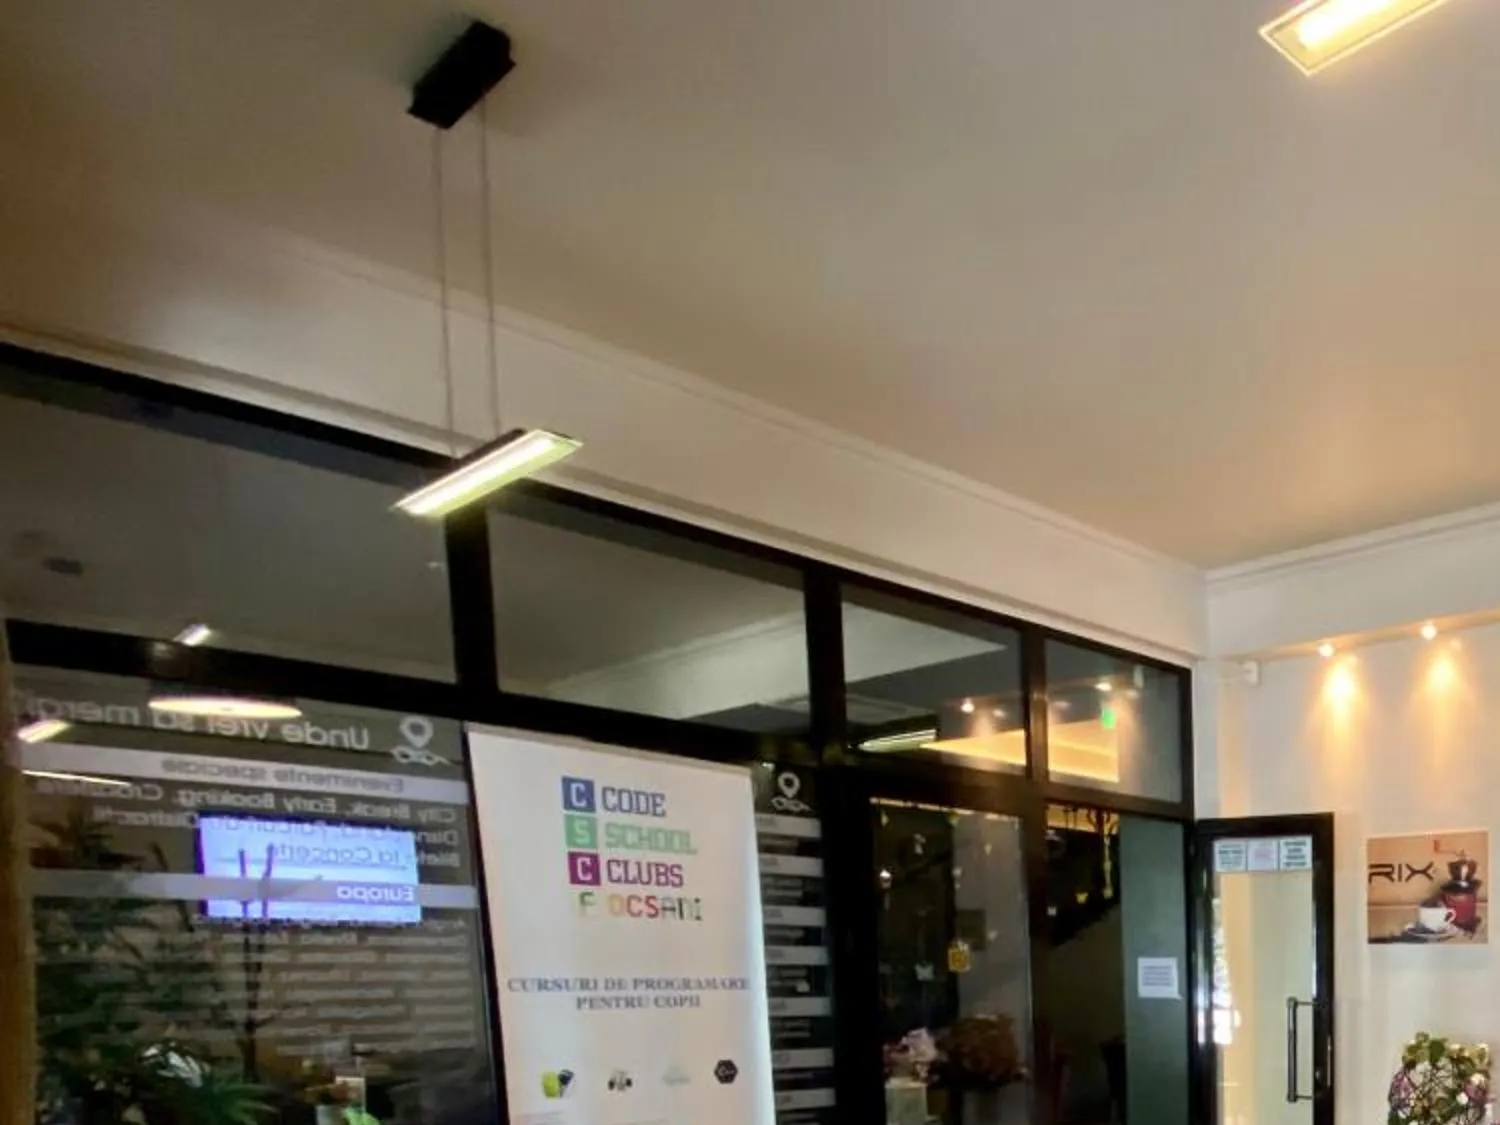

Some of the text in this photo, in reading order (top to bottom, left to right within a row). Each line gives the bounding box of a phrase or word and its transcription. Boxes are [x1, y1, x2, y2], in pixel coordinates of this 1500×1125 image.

[571, 782, 667, 817] C CODE
[574, 819, 698, 855] S SCHOOL
[577, 857, 684, 888] C CLUBS
[1368, 861, 1434, 884] RIX
[507, 976, 598, 993] CURSURI
[604, 977, 629, 992] DE
[576, 994, 650, 1012] PENTRU
